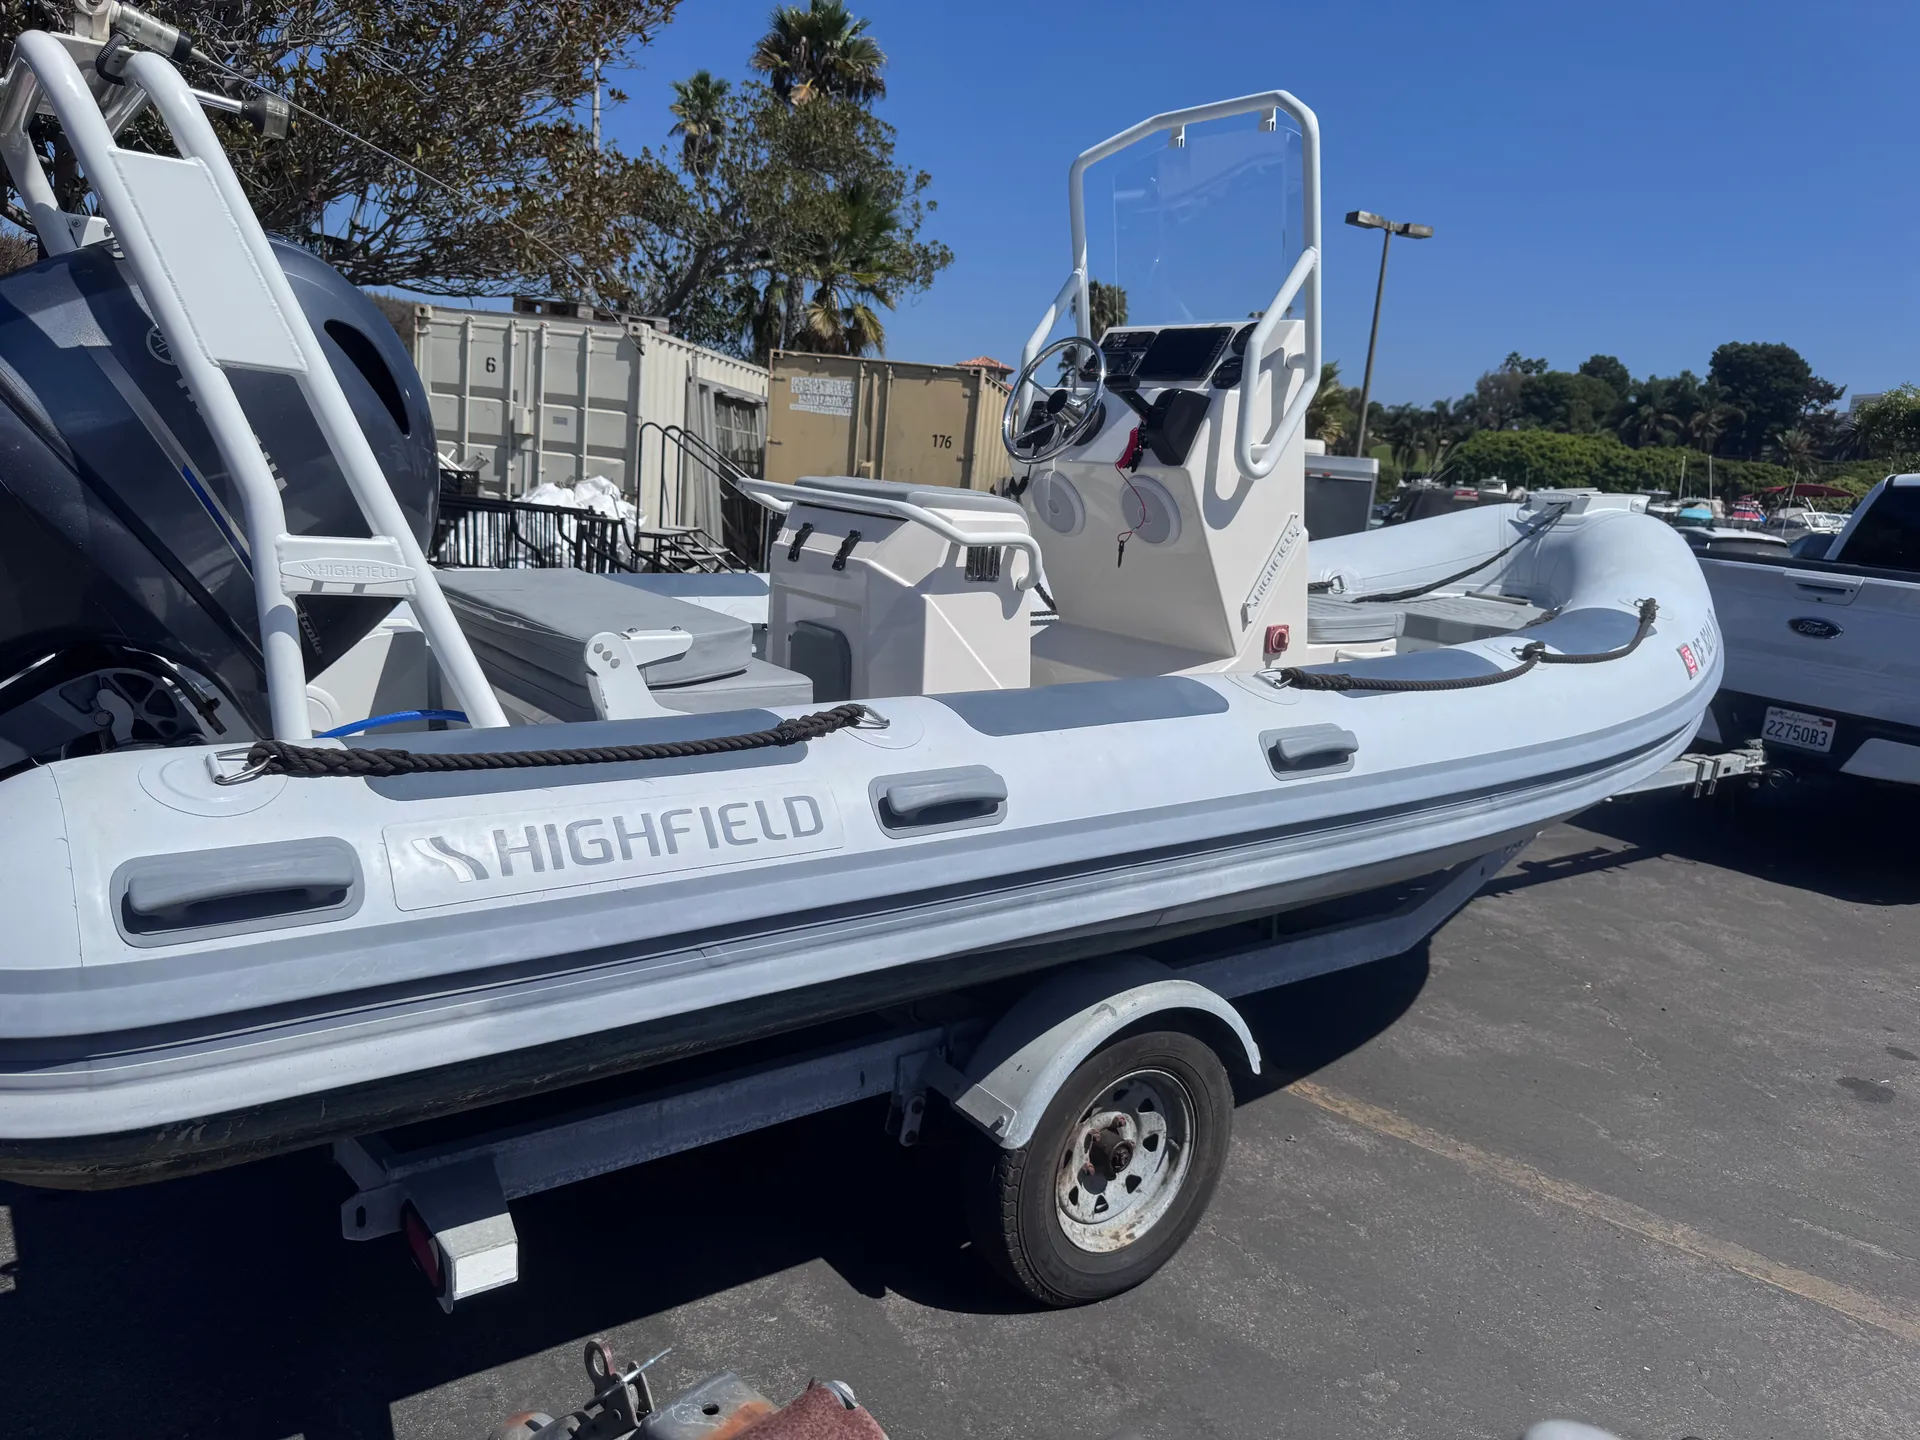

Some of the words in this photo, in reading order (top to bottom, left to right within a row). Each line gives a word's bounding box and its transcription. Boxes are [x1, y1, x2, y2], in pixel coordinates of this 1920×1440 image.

[486, 357, 496, 373] 6
[932, 434, 952, 449] 176
[317, 564, 399, 579] HIGHFIELD
[1253, 525, 1298, 602] HIGHFIELD
[297, 611, 323, 655] troke
[1798, 620, 1829, 635] Ford
[1766, 720, 1828, 747] 22750B3
[493, 795, 824, 877] HIGHFIELD
